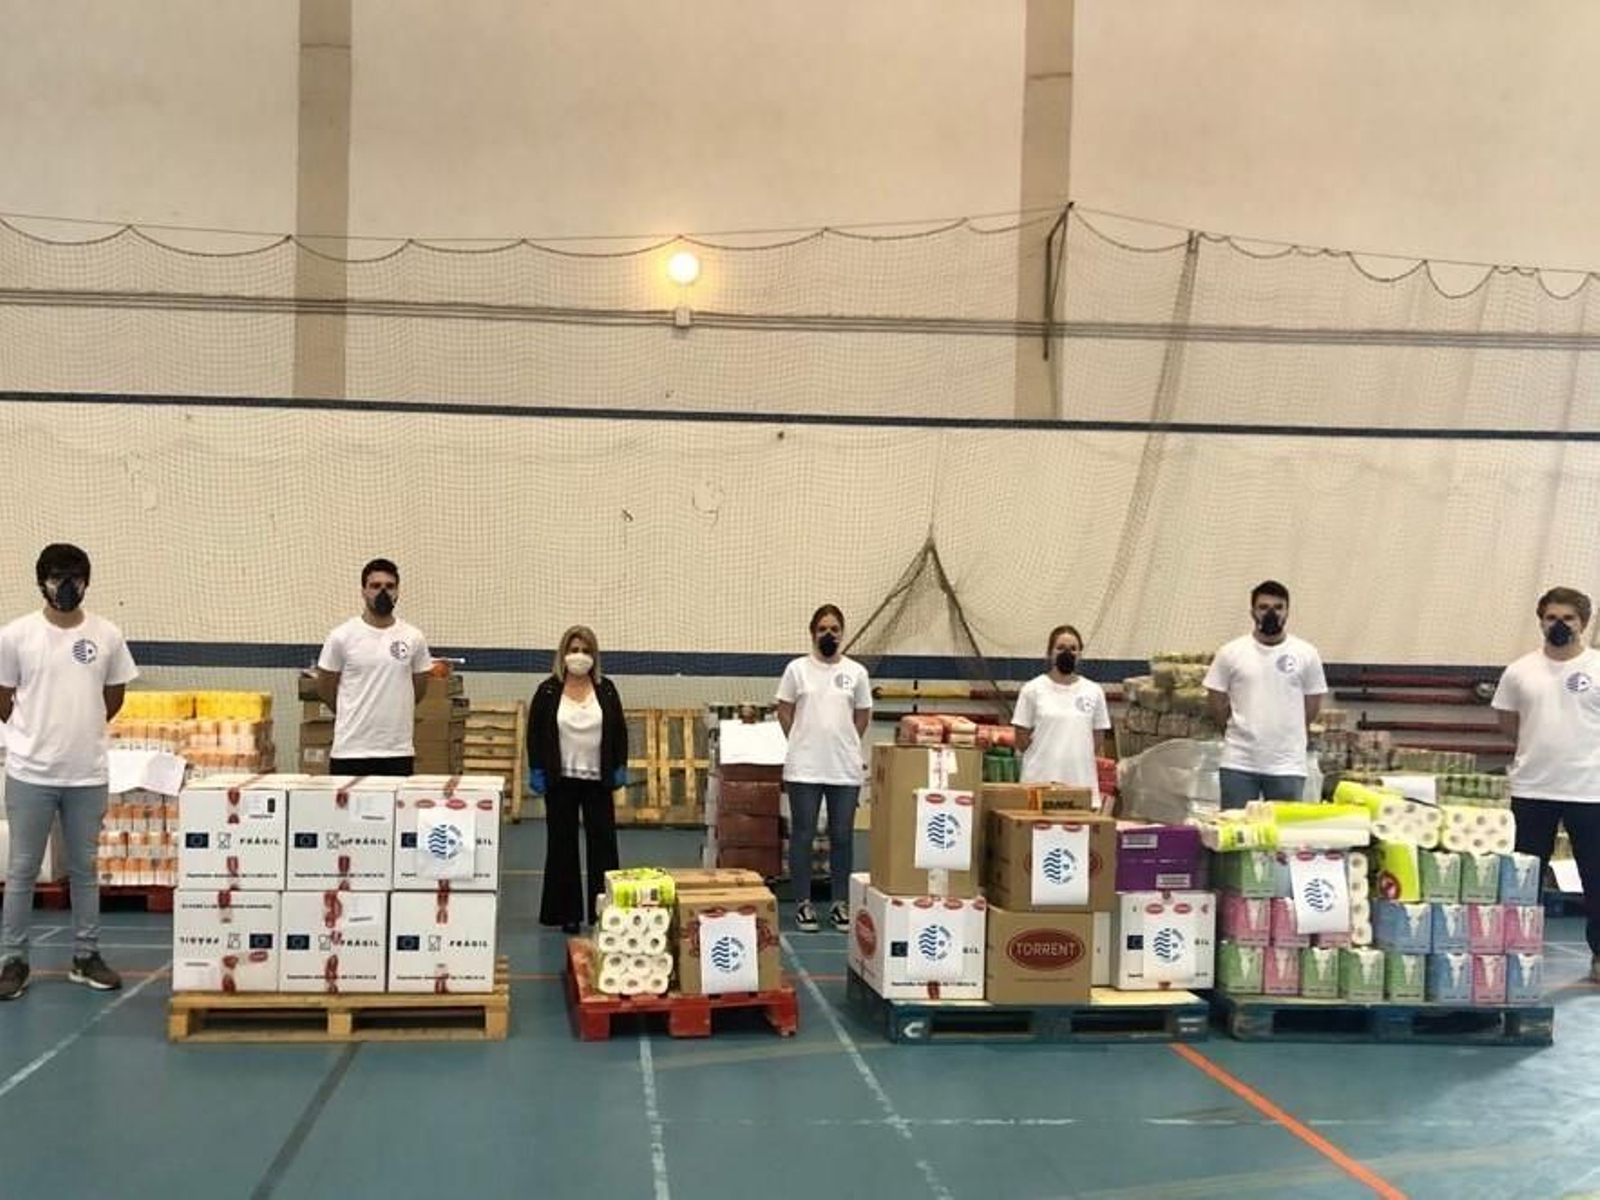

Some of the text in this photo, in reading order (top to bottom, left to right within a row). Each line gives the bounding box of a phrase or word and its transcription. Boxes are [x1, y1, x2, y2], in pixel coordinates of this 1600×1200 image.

[239, 837, 280, 846] FRÁGIL
[348, 837, 387, 846] FRÁGIL
[450, 938, 488, 947] FRÁGIL
[1015, 941, 1075, 957] TORRENT
